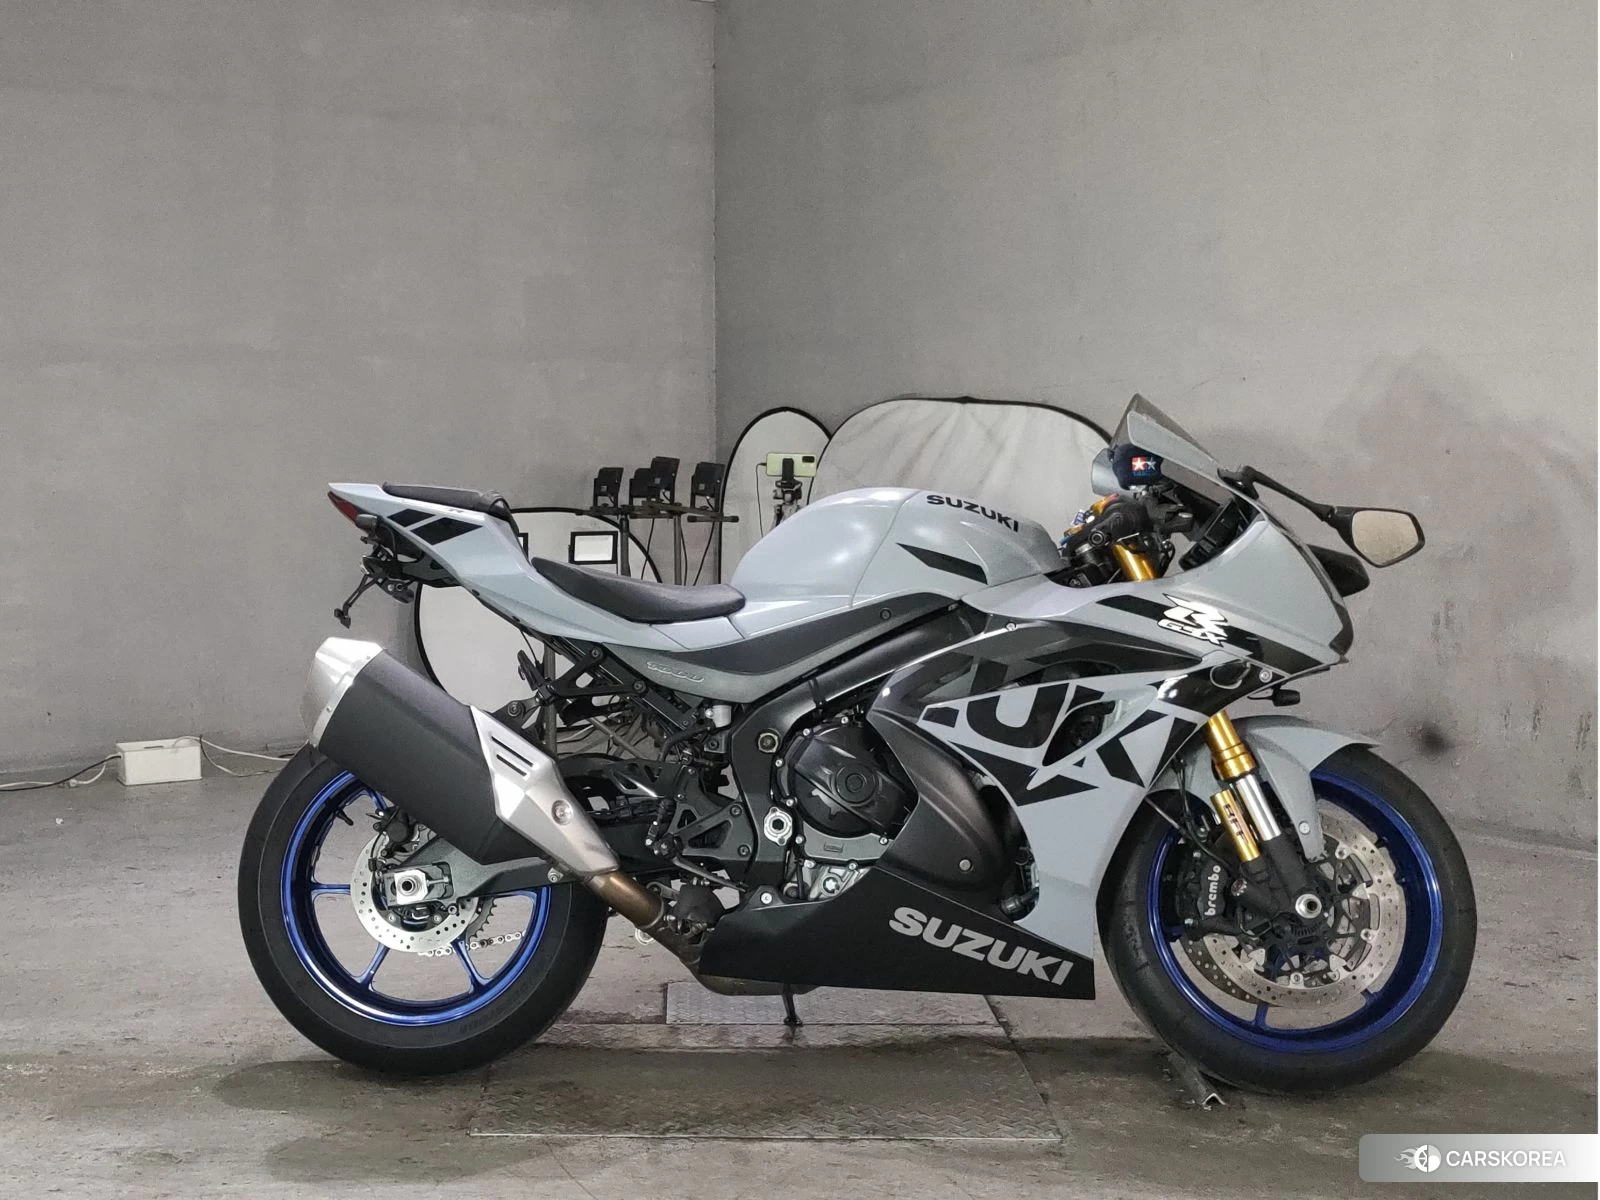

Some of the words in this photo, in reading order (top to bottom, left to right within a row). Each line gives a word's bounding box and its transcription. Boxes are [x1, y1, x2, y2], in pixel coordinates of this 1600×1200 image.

[926, 495, 1019, 533] SUZUKI
[1204, 865, 1221, 916] brembo
[889, 907, 1074, 985] SUZUKI
